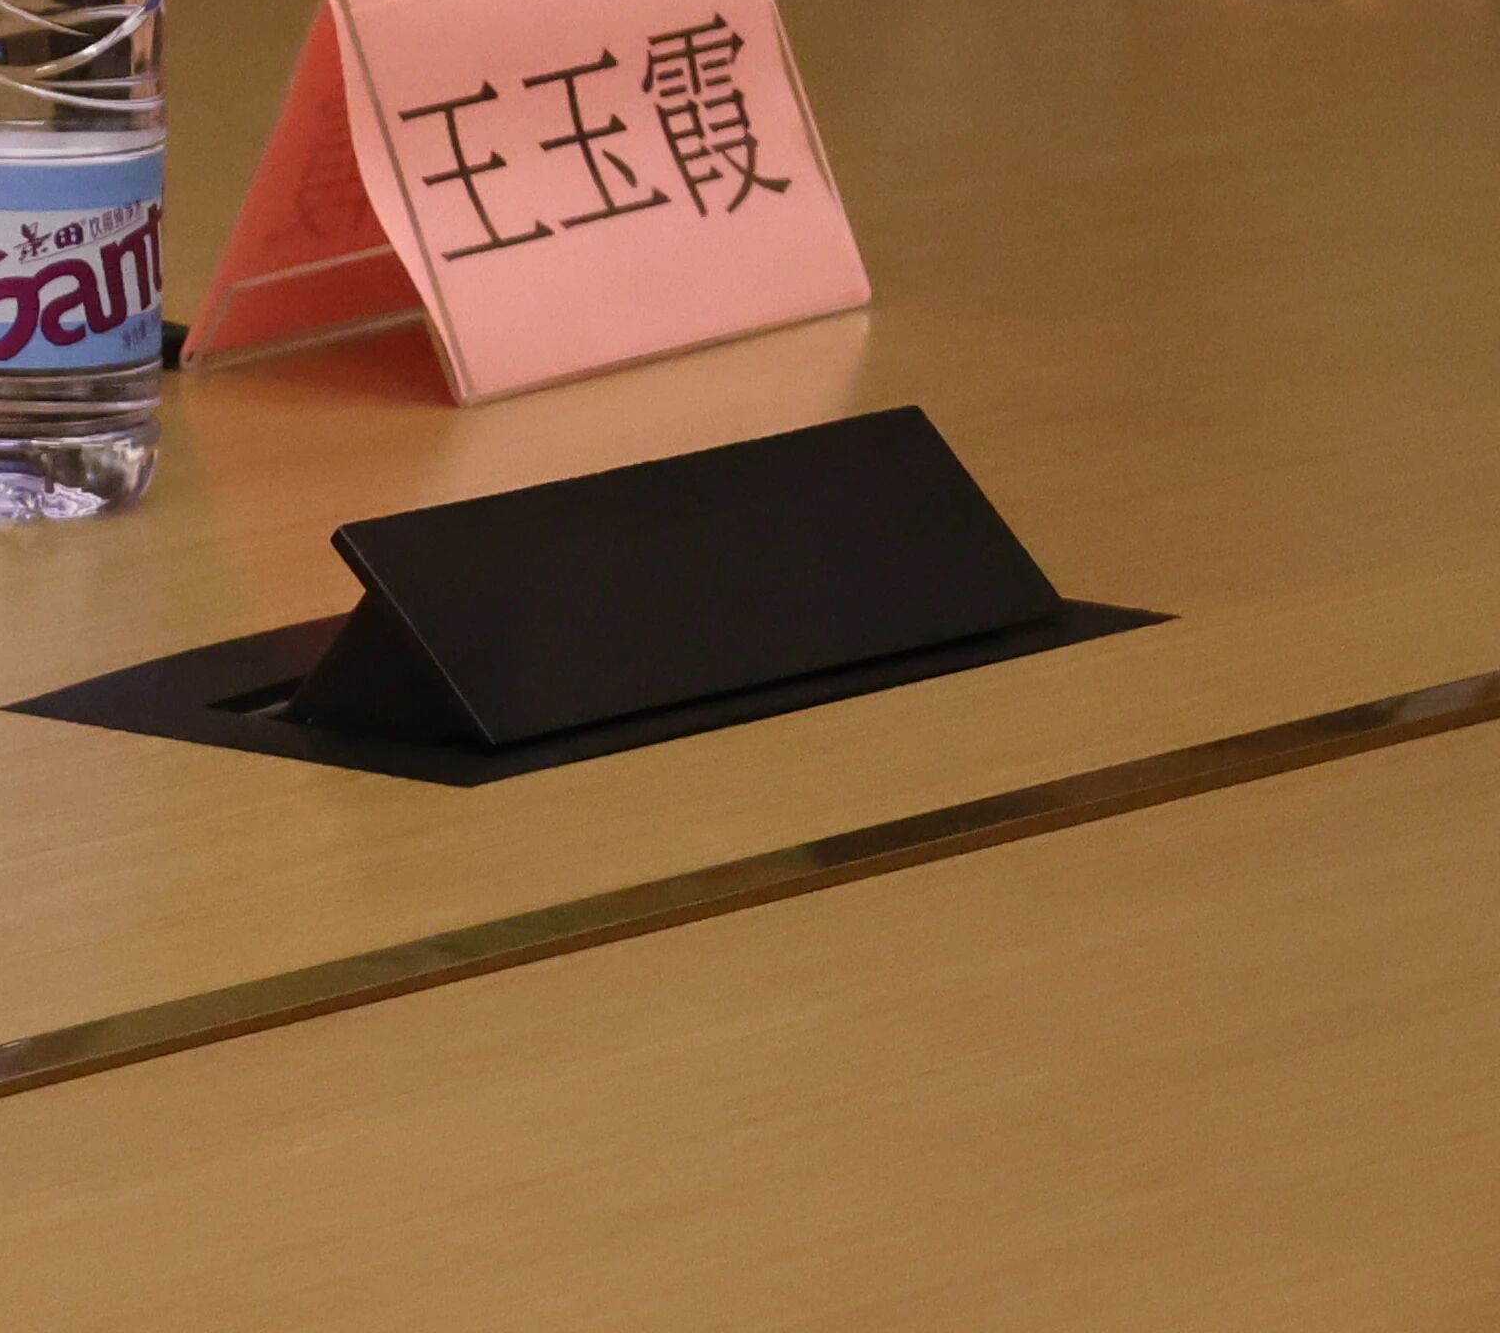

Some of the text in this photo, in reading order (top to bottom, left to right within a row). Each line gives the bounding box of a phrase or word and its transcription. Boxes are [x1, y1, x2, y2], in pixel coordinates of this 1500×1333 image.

[398, 13, 792, 262] 王玉霞
[14, 221, 85, 263] 景田
